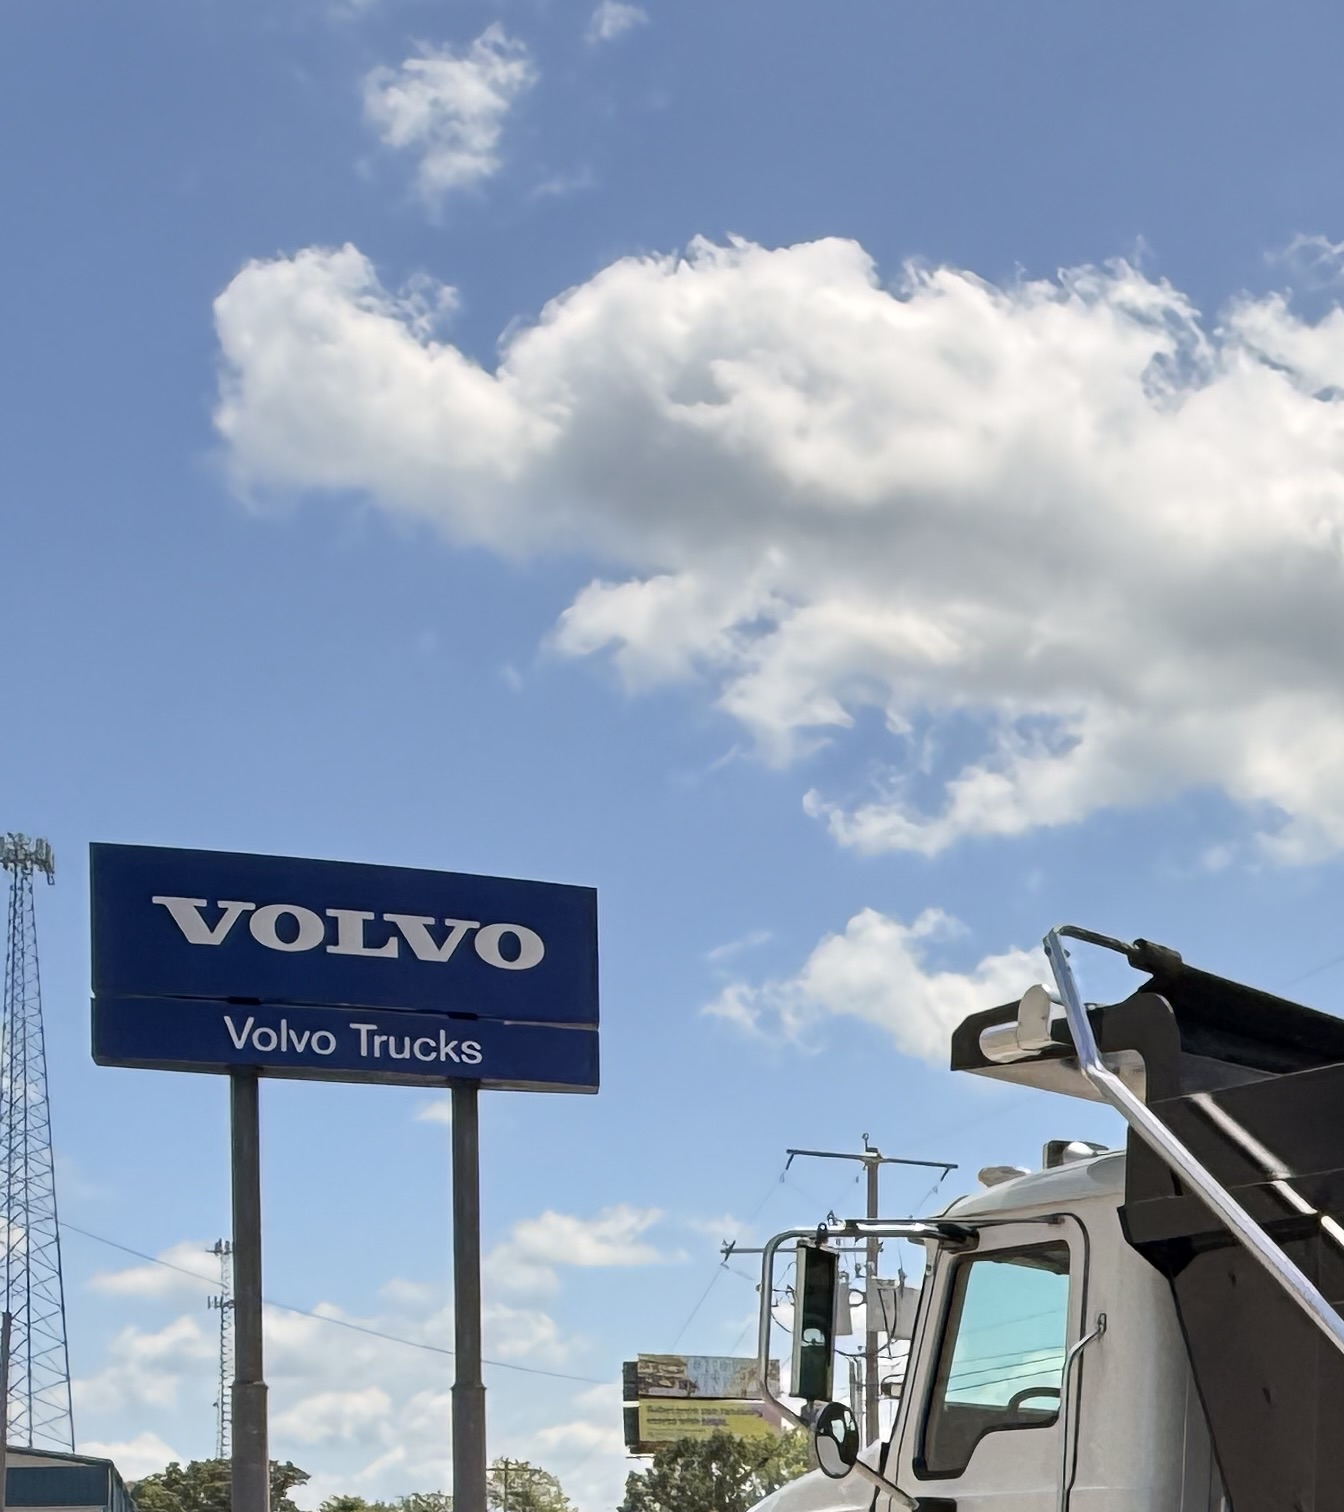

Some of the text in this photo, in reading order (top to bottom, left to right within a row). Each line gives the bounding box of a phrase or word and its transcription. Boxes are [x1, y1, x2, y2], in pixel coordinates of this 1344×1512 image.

[152, 896, 545, 970] VOLVO
[223, 1015, 483, 1065] Volvo Trucks
